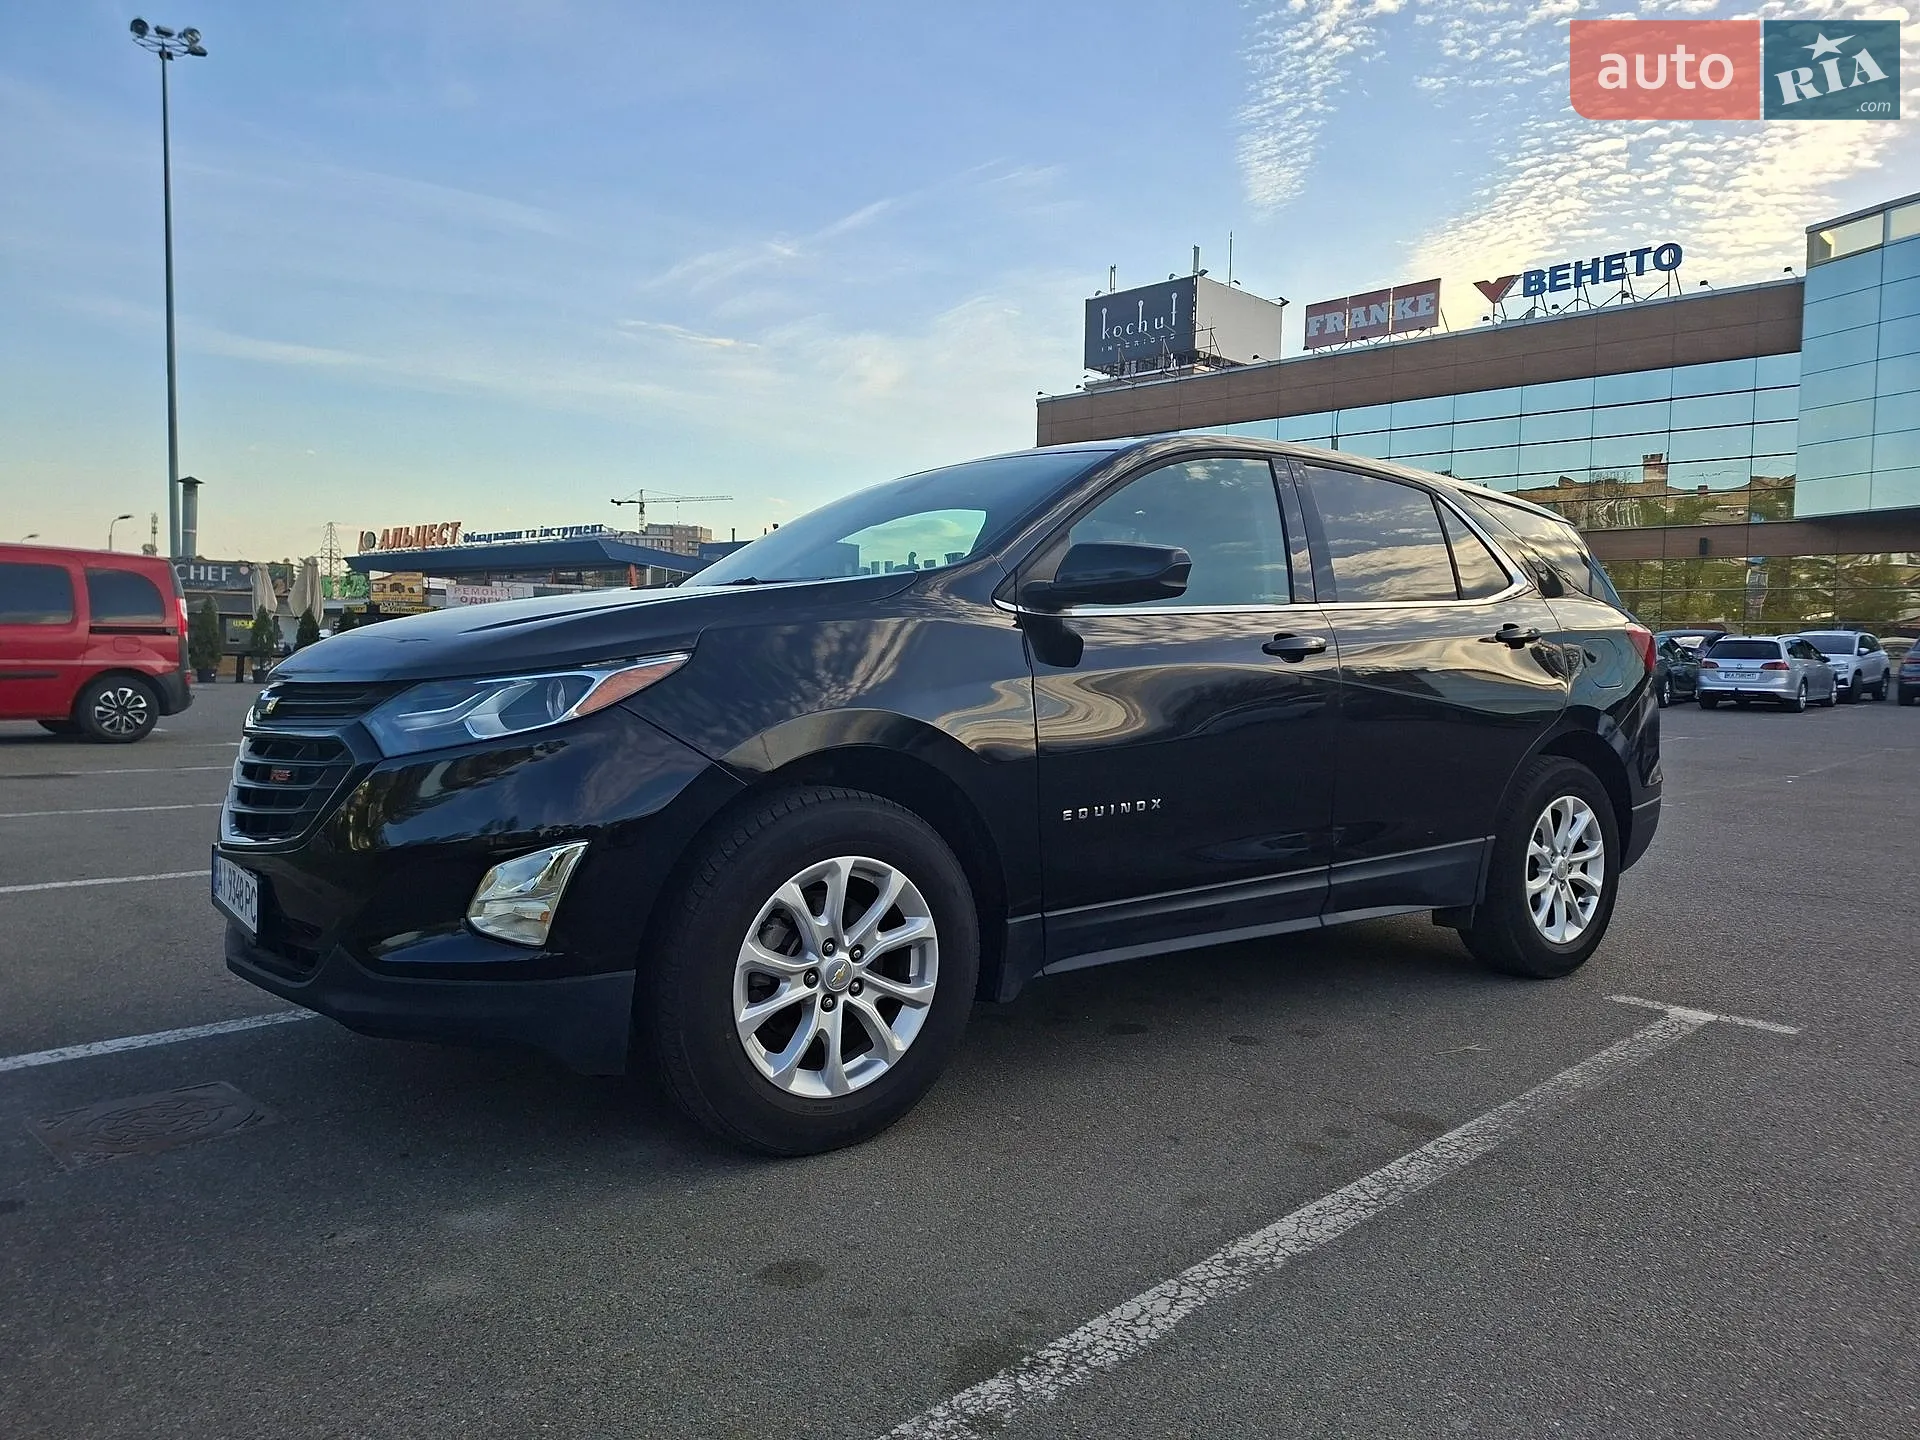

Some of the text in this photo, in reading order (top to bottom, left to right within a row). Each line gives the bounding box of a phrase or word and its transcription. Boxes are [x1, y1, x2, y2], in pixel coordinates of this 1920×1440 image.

[1523, 243, 1683, 297] ВЕНЕТО
[1102, 292, 1176, 340] kochut
[1307, 293, 1435, 337] FRANKE
[379, 522, 461, 551] АЛЬЦЕСТ
[175, 564, 232, 581] CHEF
[1063, 798, 1161, 821] EQUINOX
